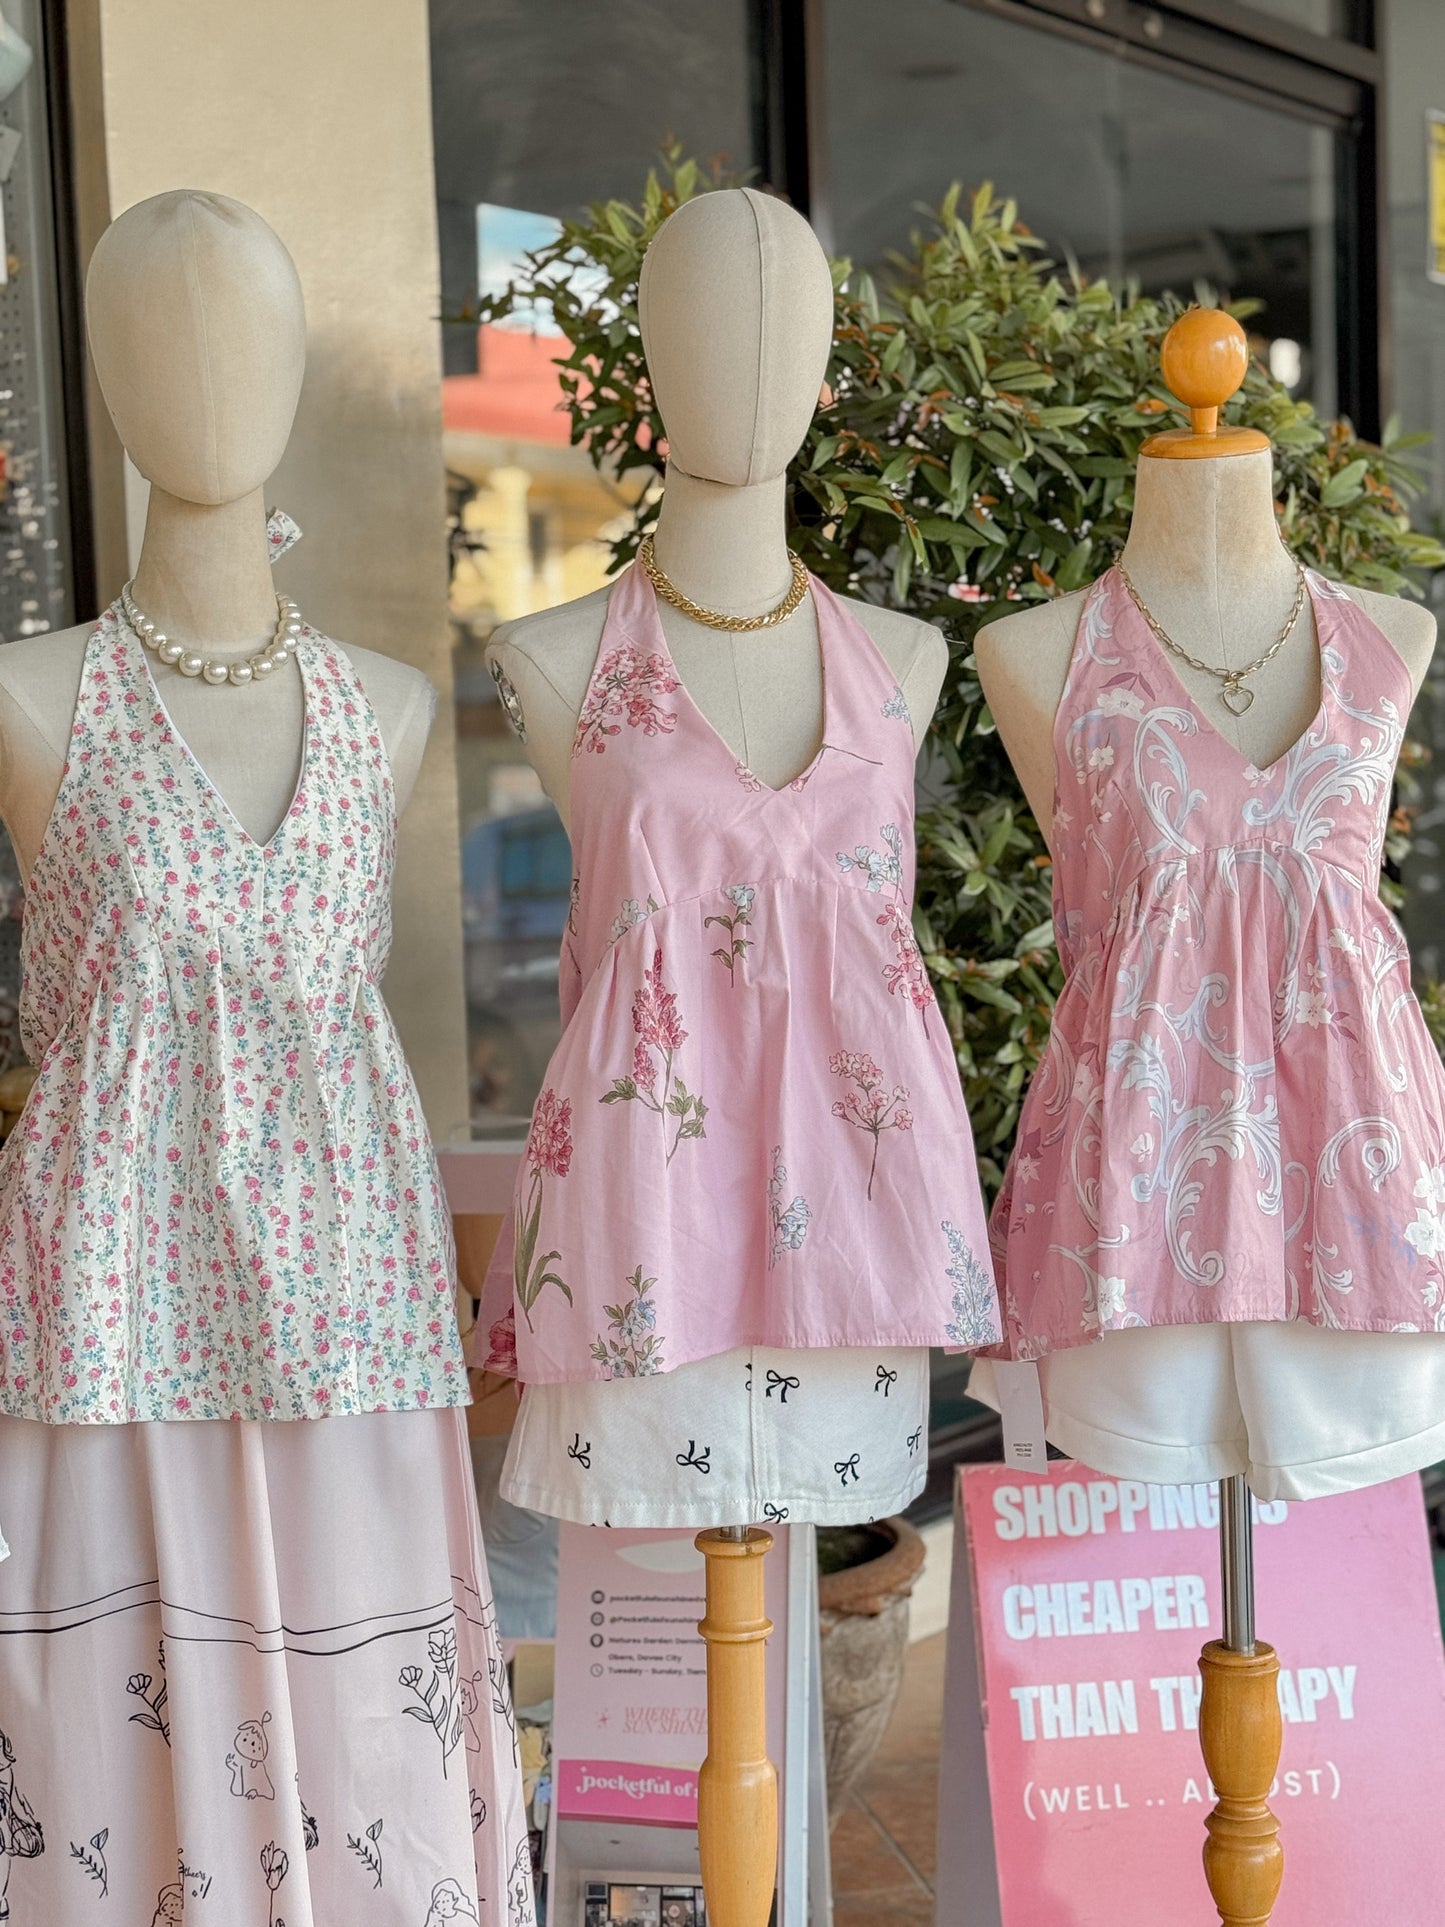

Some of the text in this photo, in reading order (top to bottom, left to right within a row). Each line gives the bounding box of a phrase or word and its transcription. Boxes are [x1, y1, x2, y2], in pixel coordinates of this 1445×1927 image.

[993, 1480, 1219, 1541] SHOPPING
[1003, 1575, 1209, 1640] CHEAPER
[665, 1654, 682, 1664] City
[608, 1667, 642, 1677] Tuesday
[625, 1706, 680, 1721] WHERE
[1009, 1665, 1357, 1742] THAN THAPY
[622, 1720, 707, 1736] SUN SHINE
[576, 1775, 671, 1799] pocketful
[674, 1782, 693, 1797] of
[1023, 1781, 1130, 1821] (WELL
